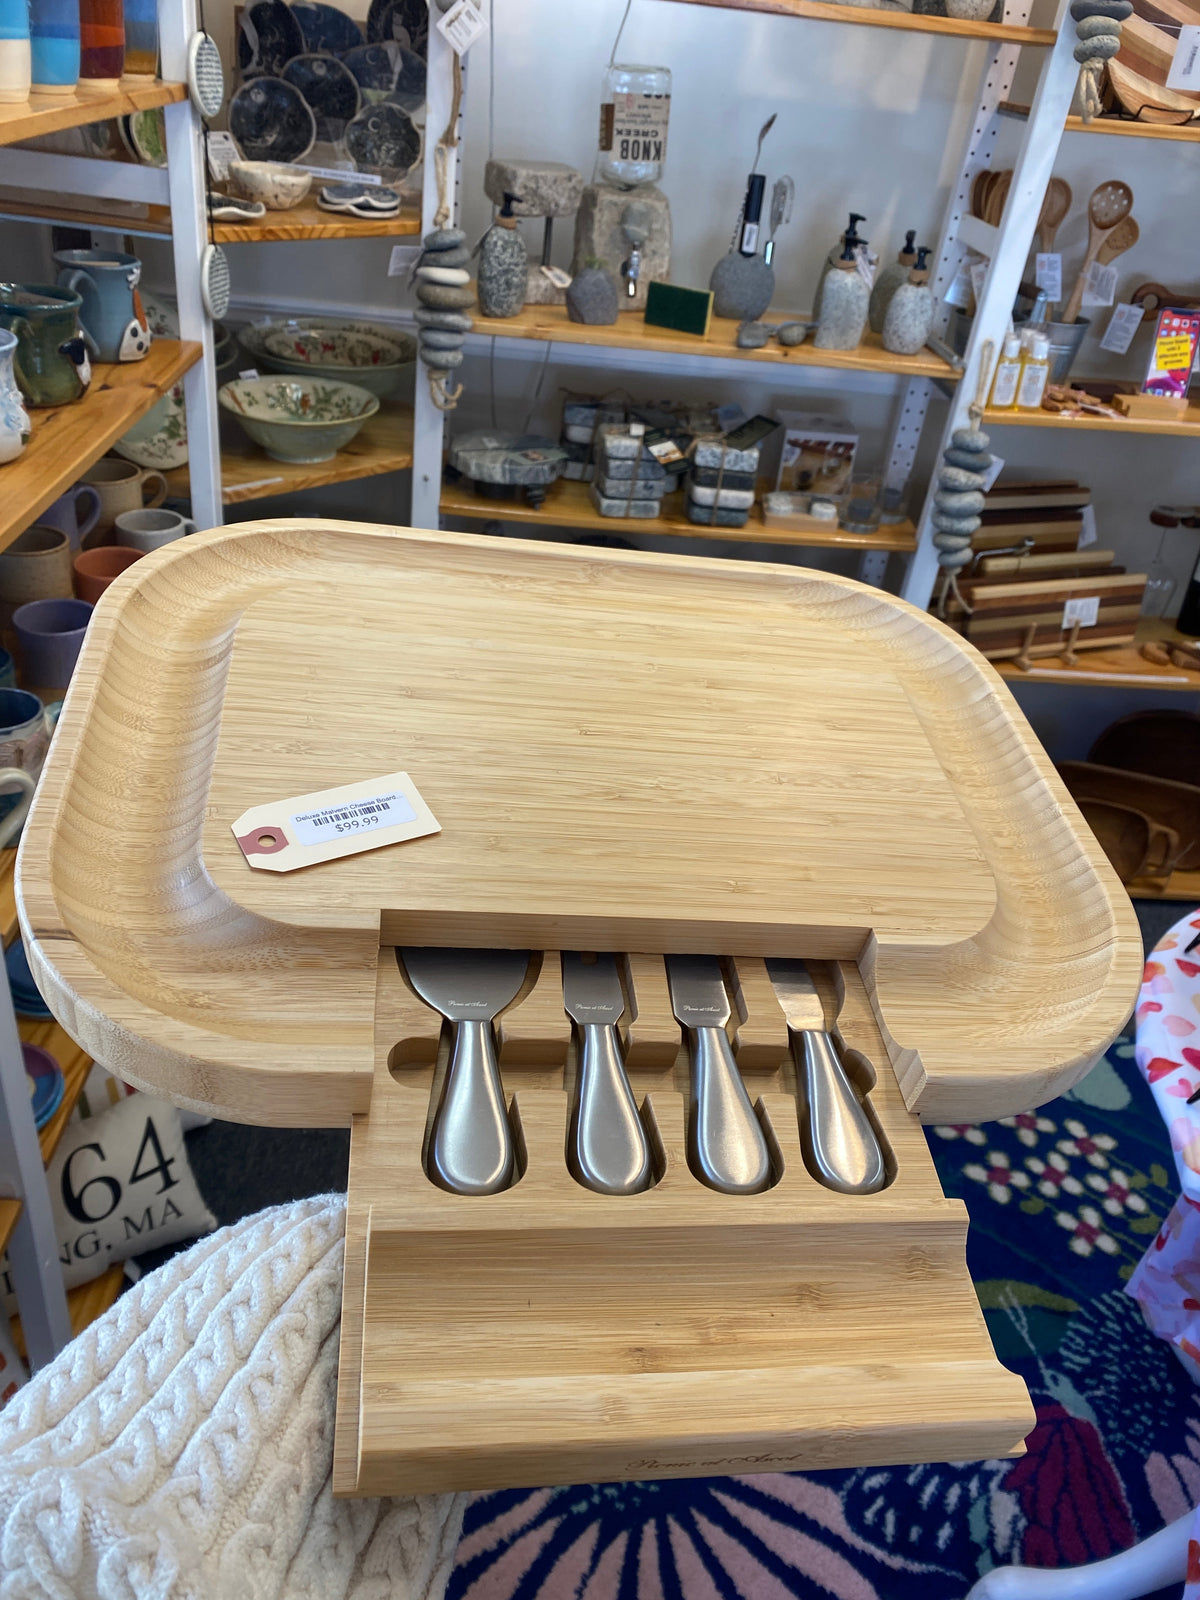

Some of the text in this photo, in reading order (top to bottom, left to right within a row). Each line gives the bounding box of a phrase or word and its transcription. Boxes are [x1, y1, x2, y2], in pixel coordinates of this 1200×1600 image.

[616, 129, 659, 138] CREEK
[620, 139, 662, 161] KNOB
[295, 812, 320, 823] Deluxe
[321, 806, 349, 817] Malvern
[349, 800, 376, 810] Cheese
[335, 815, 379, 833] $99.99
[122, 1198, 183, 1241] MA
